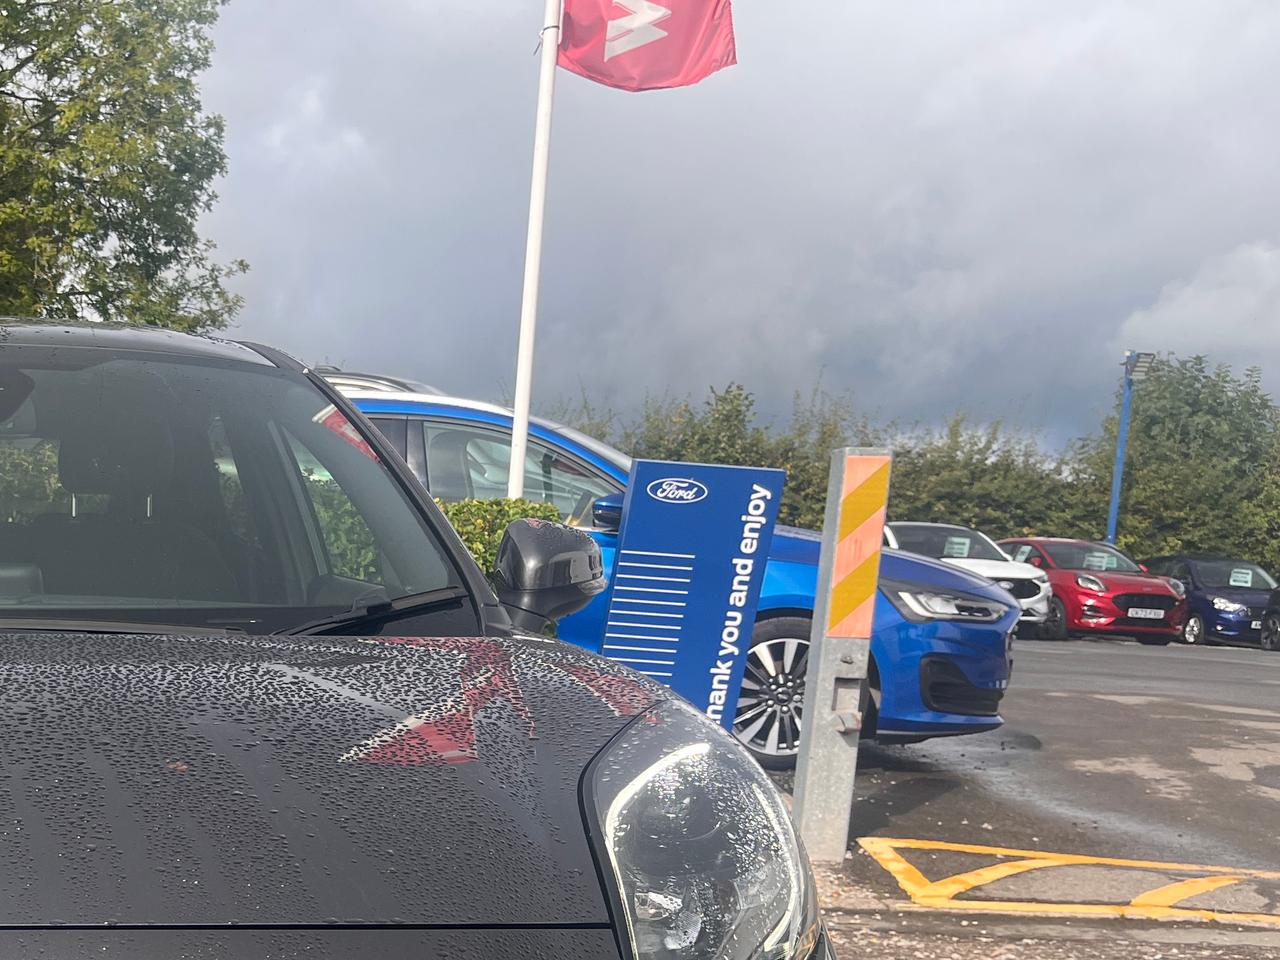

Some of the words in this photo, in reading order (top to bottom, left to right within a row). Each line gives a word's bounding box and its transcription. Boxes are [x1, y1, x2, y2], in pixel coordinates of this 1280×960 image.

[656, 479, 697, 499] Ford
[740, 483, 772, 553] enjoy
[729, 557, 754, 608] and
[719, 611, 742, 657] you
